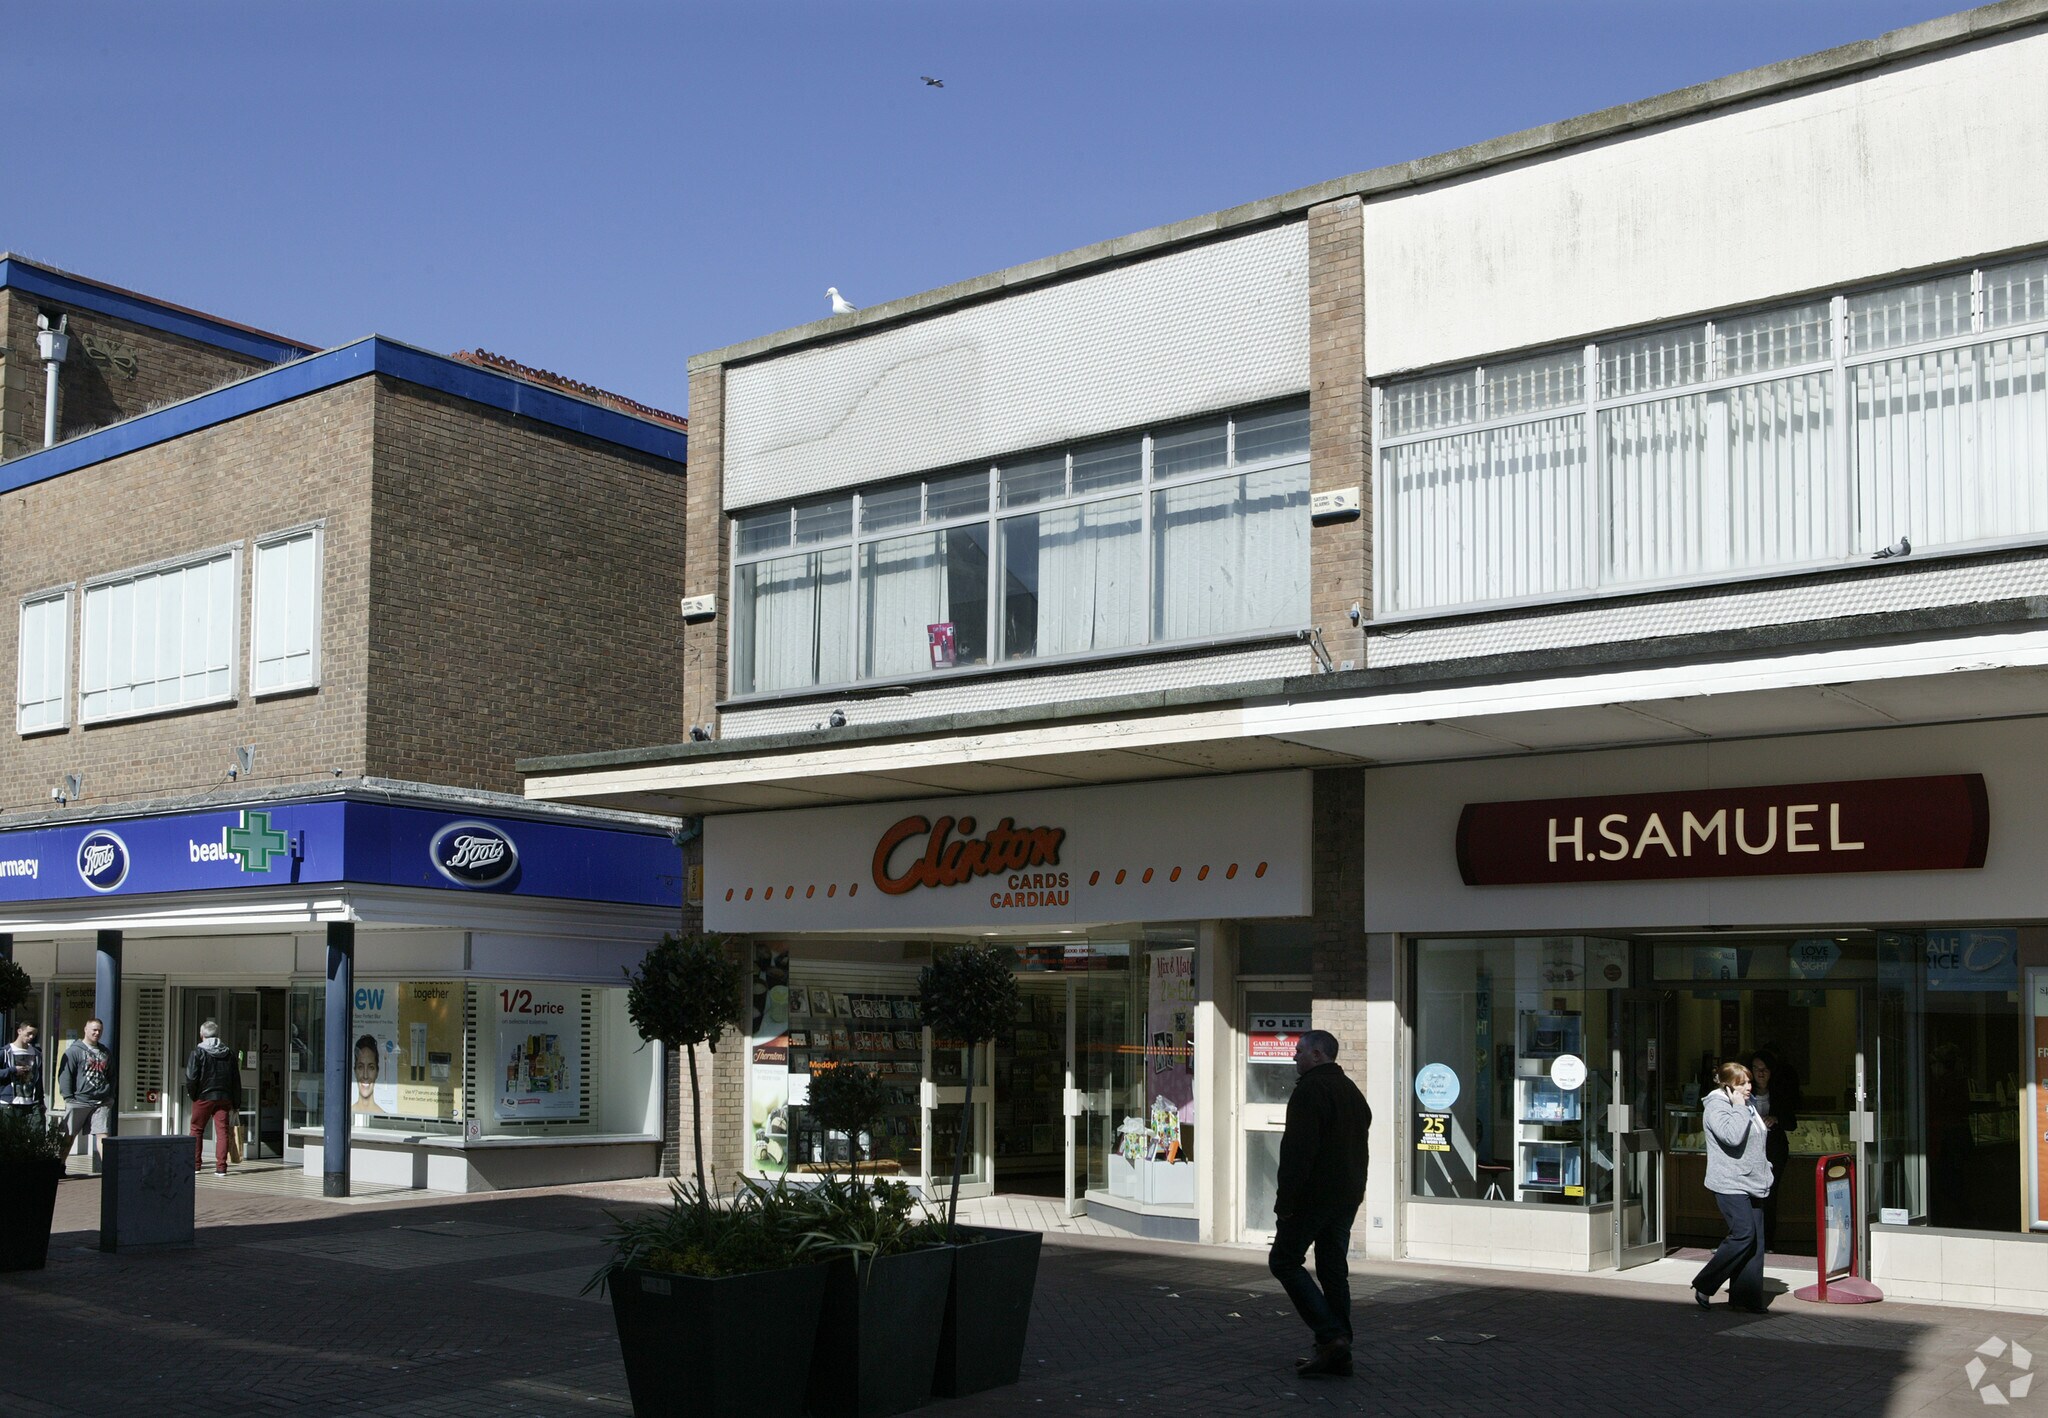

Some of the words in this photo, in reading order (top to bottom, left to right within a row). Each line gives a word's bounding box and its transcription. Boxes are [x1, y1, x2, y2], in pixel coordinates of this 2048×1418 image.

[1548, 803, 1865, 862] H.SAMUEL
[83, 843, 115, 876] Boots
[446, 835, 504, 869] Boots
[872, 815, 1066, 895] Clinton
[0, 859, 39, 879] rmacy
[1008, 872, 1069, 890] CARDS
[990, 890, 1069, 908] CARDIAU
[1801, 946, 1829, 956] LOVE
[1927, 937, 1960, 954] ALF
[1801, 961, 1829, 970] SIGHT
[80, 987, 96, 997] bette
[355, 988, 385, 1010] ew
[414, 987, 449, 1001] together
[500, 989, 532, 1013] 1/2
[534, 1002, 564, 1016] price
[1477, 1021, 1488, 1035] HT
[2038, 1047, 2048, 1057] FR
[1423, 1117, 1445, 1134] 25
